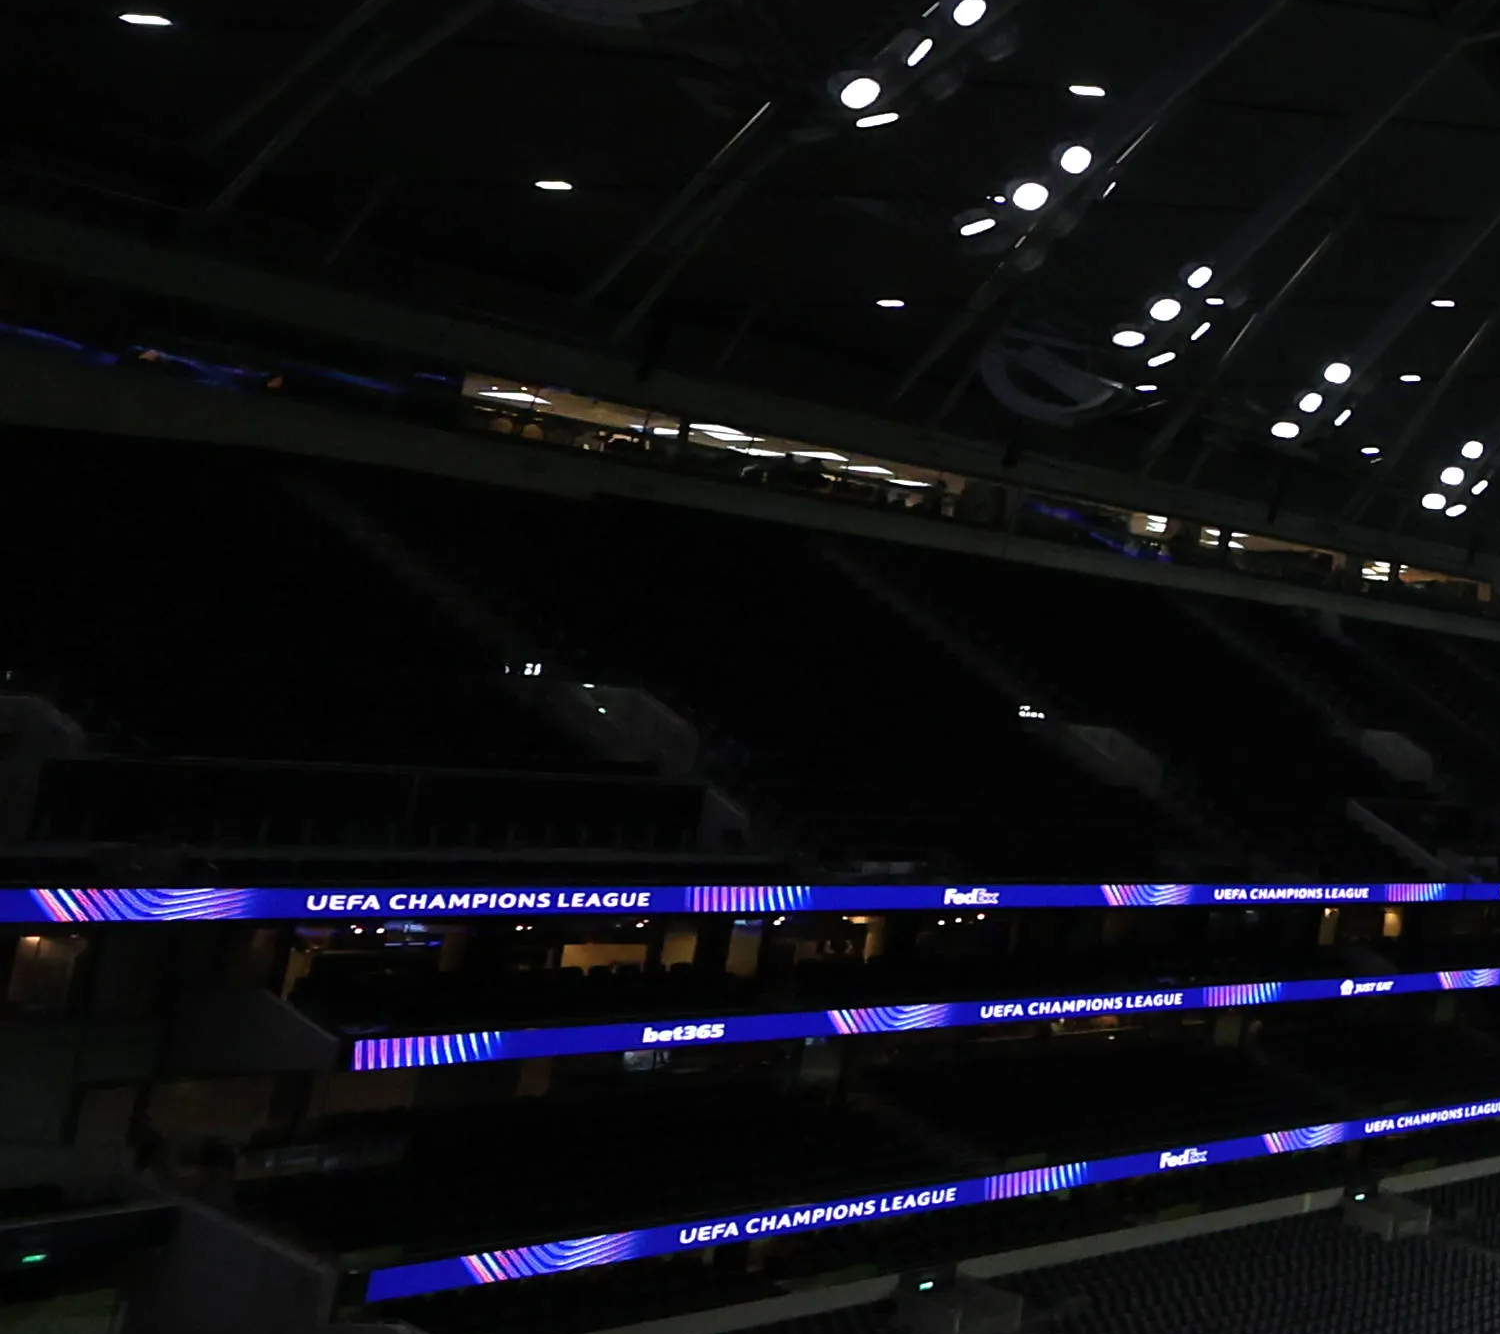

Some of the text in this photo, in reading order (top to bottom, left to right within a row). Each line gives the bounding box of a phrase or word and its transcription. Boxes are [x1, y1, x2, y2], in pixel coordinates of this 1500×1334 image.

[307, 893, 650, 910] UEFA CHAMPIONS LEAGUE
[944, 889, 999, 904] FedEx
[1214, 888, 1369, 899] UEFA CHAMPIONS LEAGUE
[981, 993, 1183, 1018] UEFA CHAMPIONS LEAGUE
[643, 1024, 724, 1042] bet365
[1365, 1120, 1394, 1133] UEFA
[1397, 1108, 1463, 1128] CHAMPIONS
[1160, 1148, 1207, 1168] FedEx
[680, 1188, 956, 1243] UEFA CHAMPIONS LEAGUE
